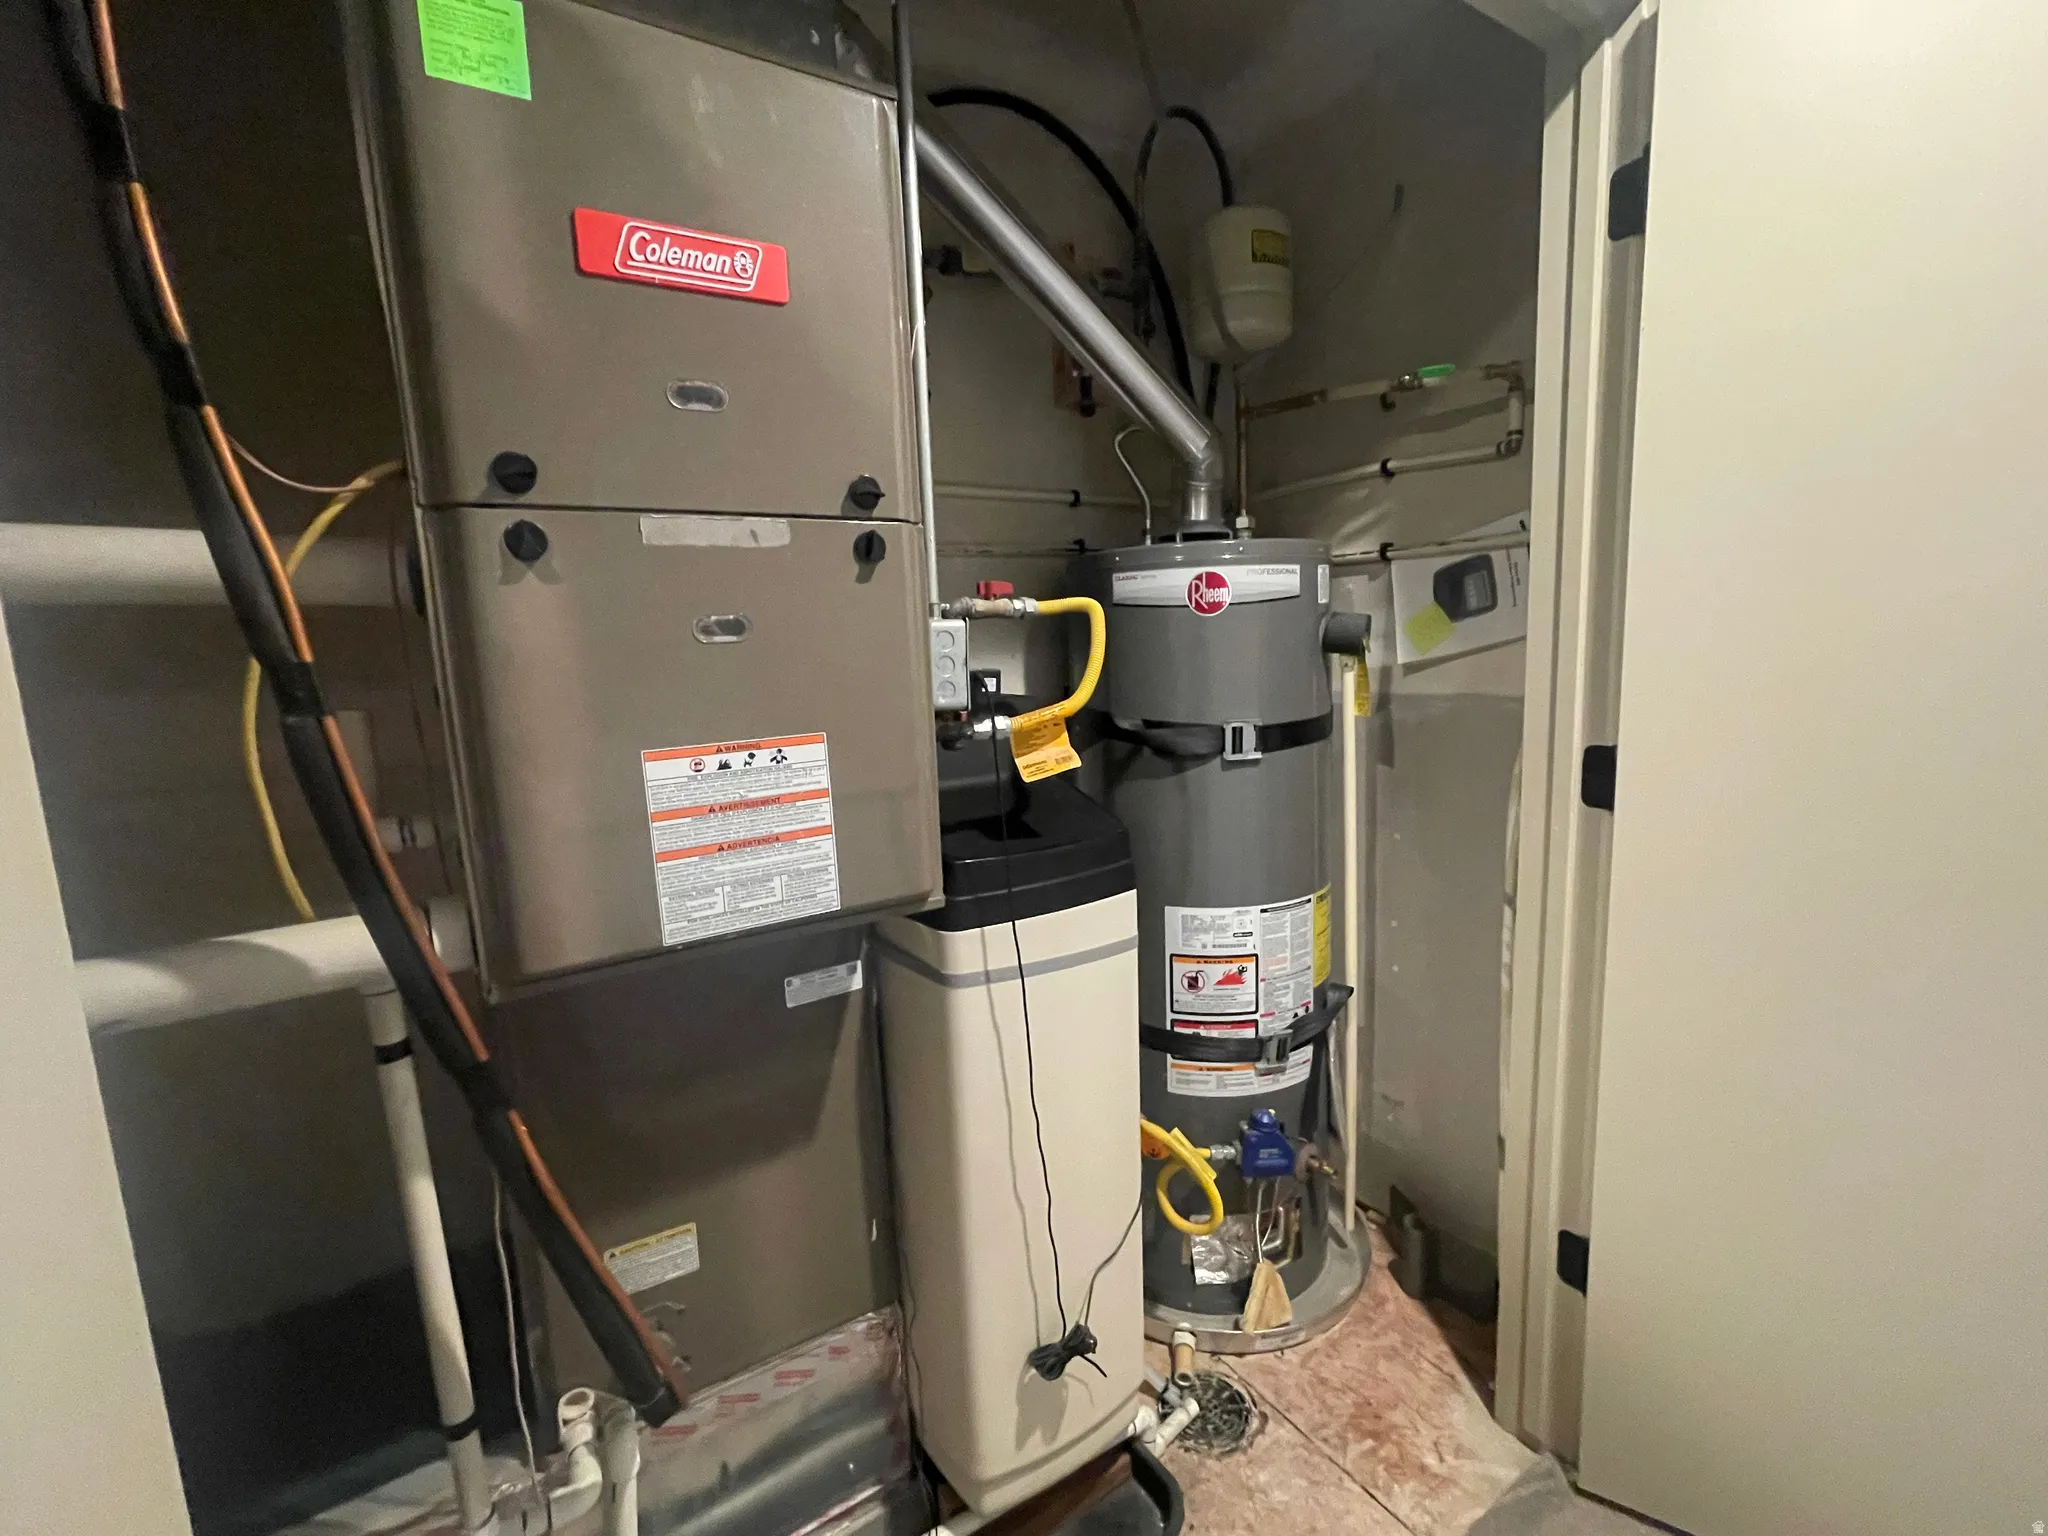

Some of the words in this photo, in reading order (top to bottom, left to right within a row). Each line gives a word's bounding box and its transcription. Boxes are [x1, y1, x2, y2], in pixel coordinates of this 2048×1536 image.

[629, 231, 731, 274] Coleman
[1246, 567, 1298, 576] PROFESSIONAL
[1190, 571, 1230, 610] Rheem
[723, 742, 762, 753] WARNING
[726, 836, 780, 851] ADVERTENCIA
